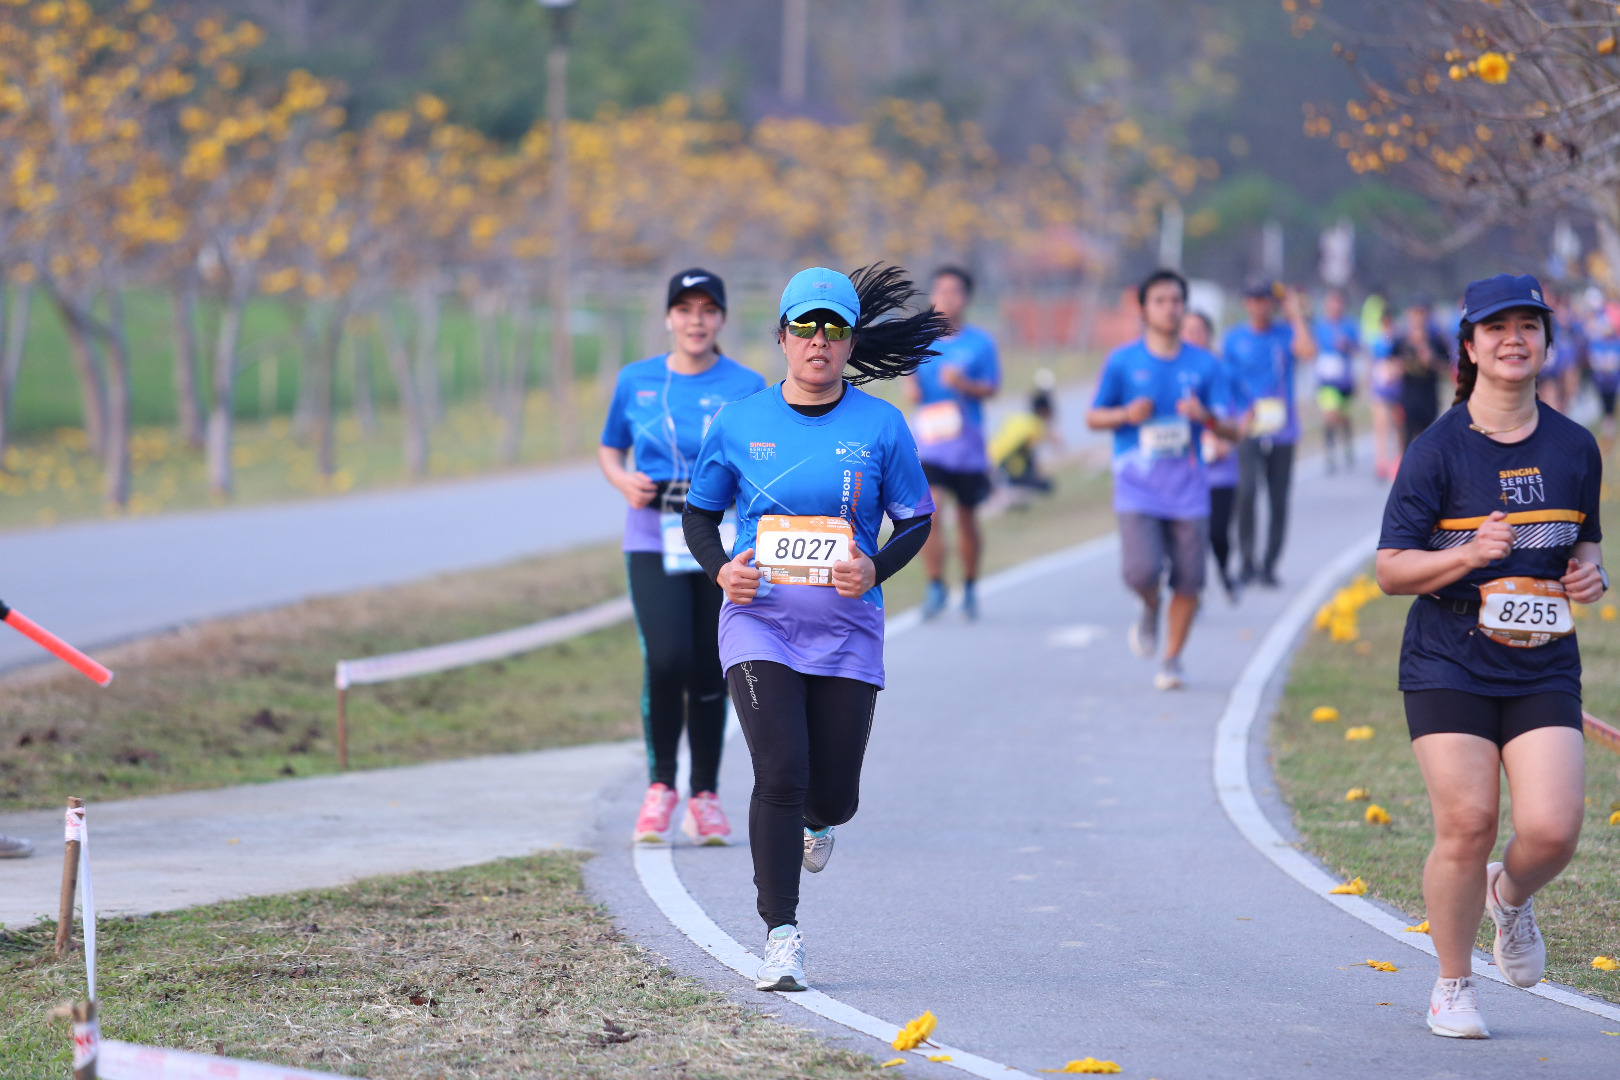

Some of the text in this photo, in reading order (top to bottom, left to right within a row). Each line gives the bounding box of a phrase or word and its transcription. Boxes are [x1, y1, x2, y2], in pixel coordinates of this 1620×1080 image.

[1499, 466, 1541, 478] SINGHA
[1500, 475, 1543, 487] SERIES
[842, 470, 851, 502] CROSS
[850, 471, 862, 512] SINGHA
[775, 538, 837, 560] 8027
[1499, 600, 1557, 625] 8255
